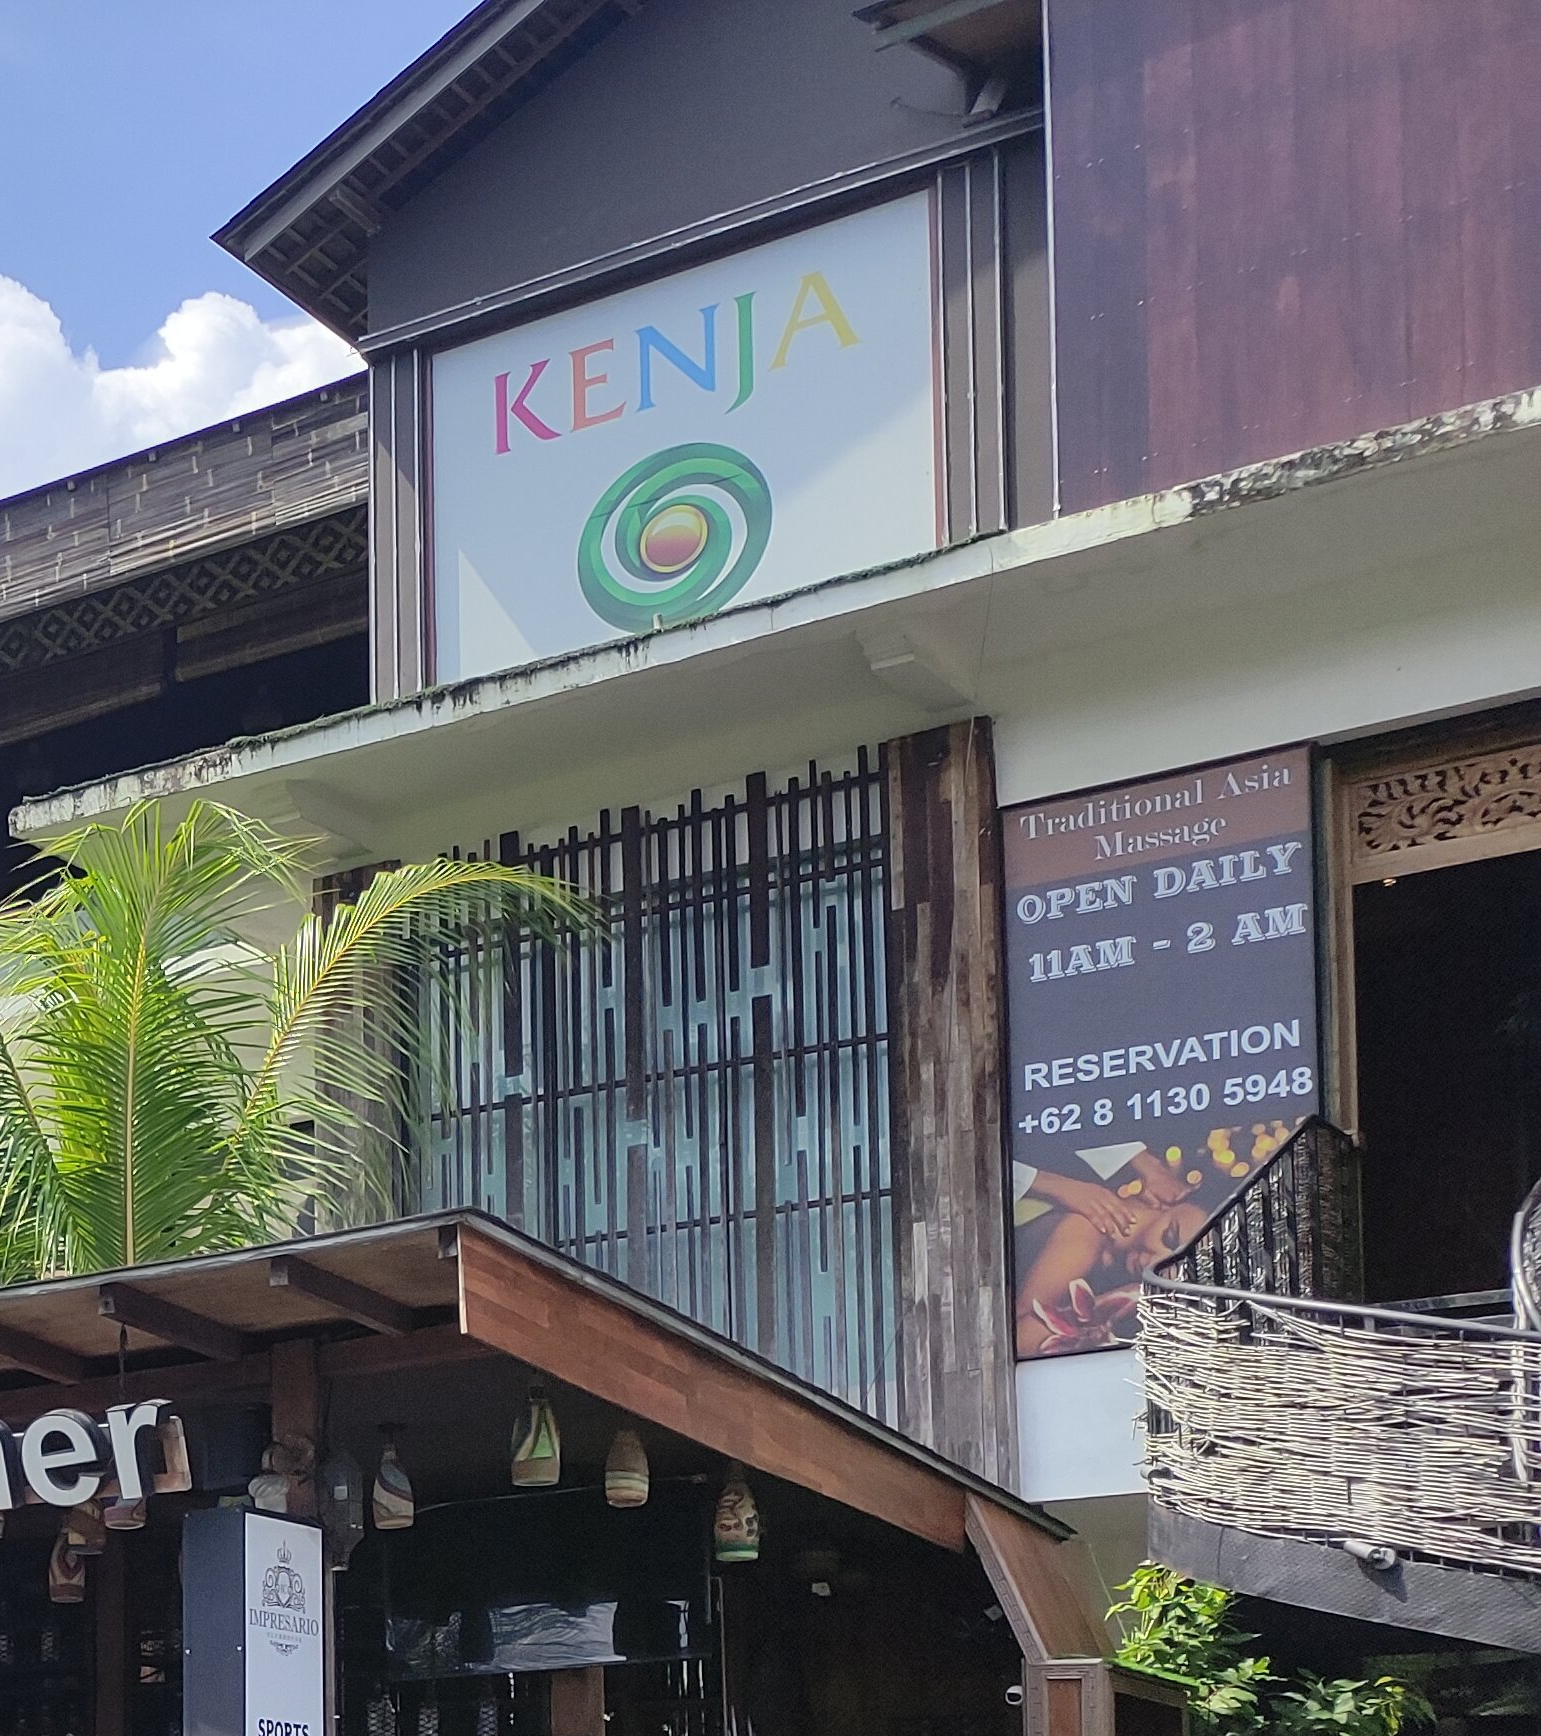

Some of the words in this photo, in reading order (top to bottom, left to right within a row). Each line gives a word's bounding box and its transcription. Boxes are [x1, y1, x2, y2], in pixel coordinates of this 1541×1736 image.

[494, 270, 862, 456] KENJA
[1019, 779, 1204, 840] Traditional
[1217, 764, 1292, 800] Asia
[1093, 816, 1227, 860] Massage
[1017, 875, 1137, 925] OPEN
[1153, 841, 1303, 899] DAILY
[1029, 935, 1136, 983] 11AM
[1187, 921, 1216, 953] 2
[1231, 903, 1308, 945] AM
[1024, 1019, 1300, 1091] RESERVATION
[1018, 1103, 1082, 1134] +62
[1093, 1098, 1114, 1126] 8
[1127, 1083, 1210, 1120] 1130
[1223, 1066, 1313, 1106] 5948
[249, 1608, 319, 1637] IMPRESARIO
